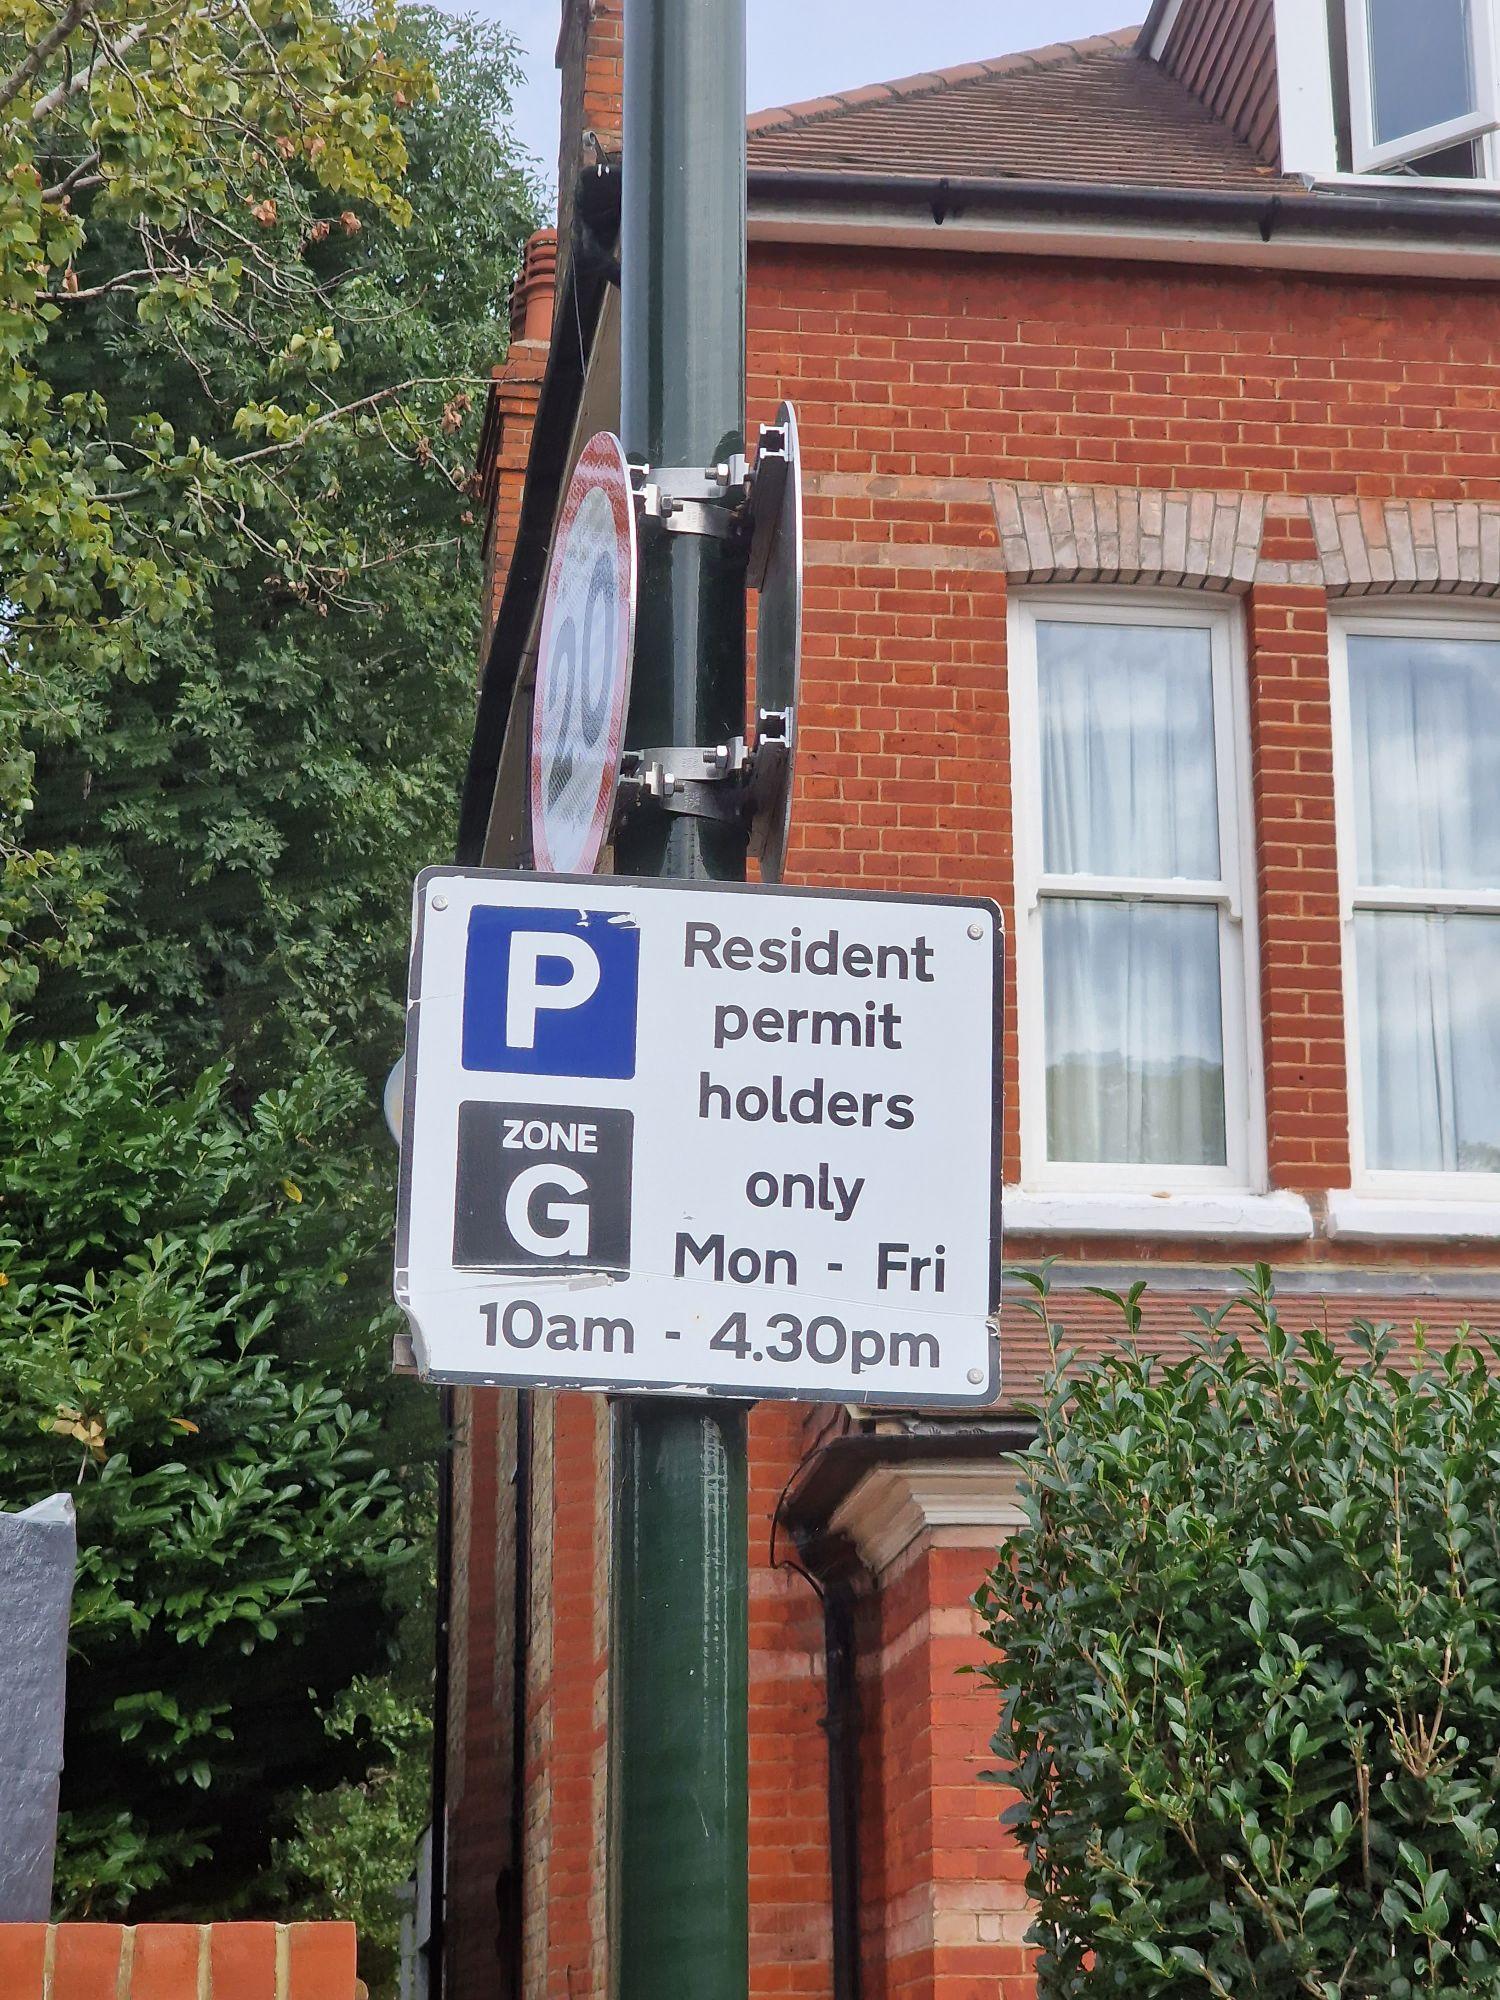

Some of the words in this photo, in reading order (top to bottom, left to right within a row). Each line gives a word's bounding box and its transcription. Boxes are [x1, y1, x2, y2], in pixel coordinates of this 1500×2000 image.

[547, 551, 614, 815] 20
[684, 921, 935, 983] Resident
[505, 930, 600, 1049] P
[714, 1000, 902, 1050] permit
[699, 1071, 915, 1130] holders
[503, 1119, 598, 1154] ZONE
[505, 1163, 590, 1259] G
[745, 1162, 866, 1222] only
[674, 1232, 797, 1286] Mon
[827, 1262, 843, 1272] -
[877, 1242, 946, 1293] Fri
[479, 1299, 634, 1354] 10am
[665, 1330, 681, 1340] -
[709, 1312, 940, 1374] 4.30pm
